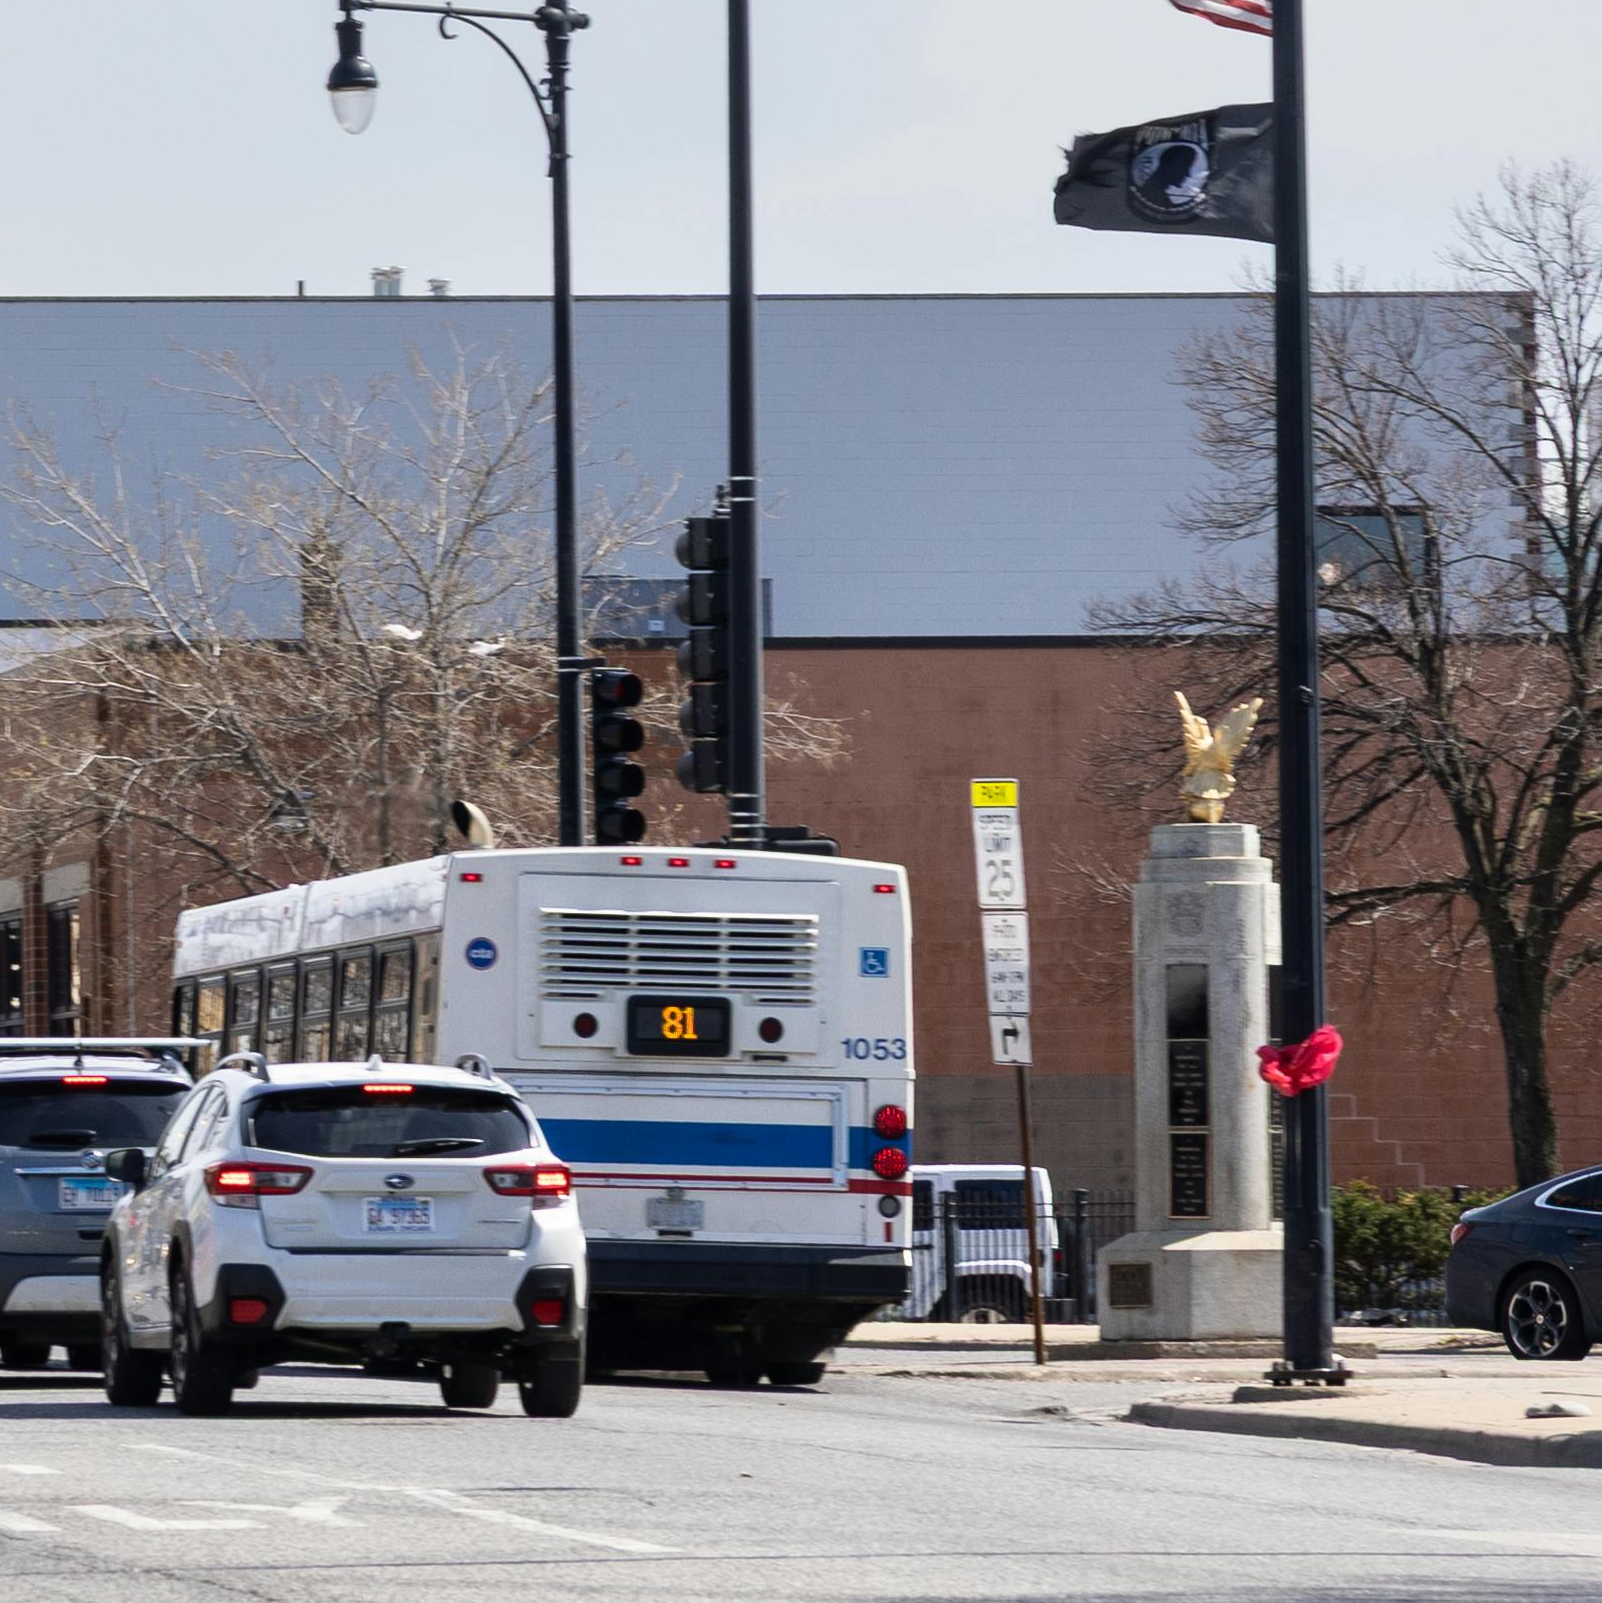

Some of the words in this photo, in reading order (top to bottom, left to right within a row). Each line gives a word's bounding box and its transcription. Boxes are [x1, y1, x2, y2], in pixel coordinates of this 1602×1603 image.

[978, 814, 1012, 831] SPEED
[983, 836, 1012, 853] LIMIT
[985, 859, 1015, 898] 25
[661, 1006, 698, 1040] 81
[840, 1038, 906, 1061] 1053
